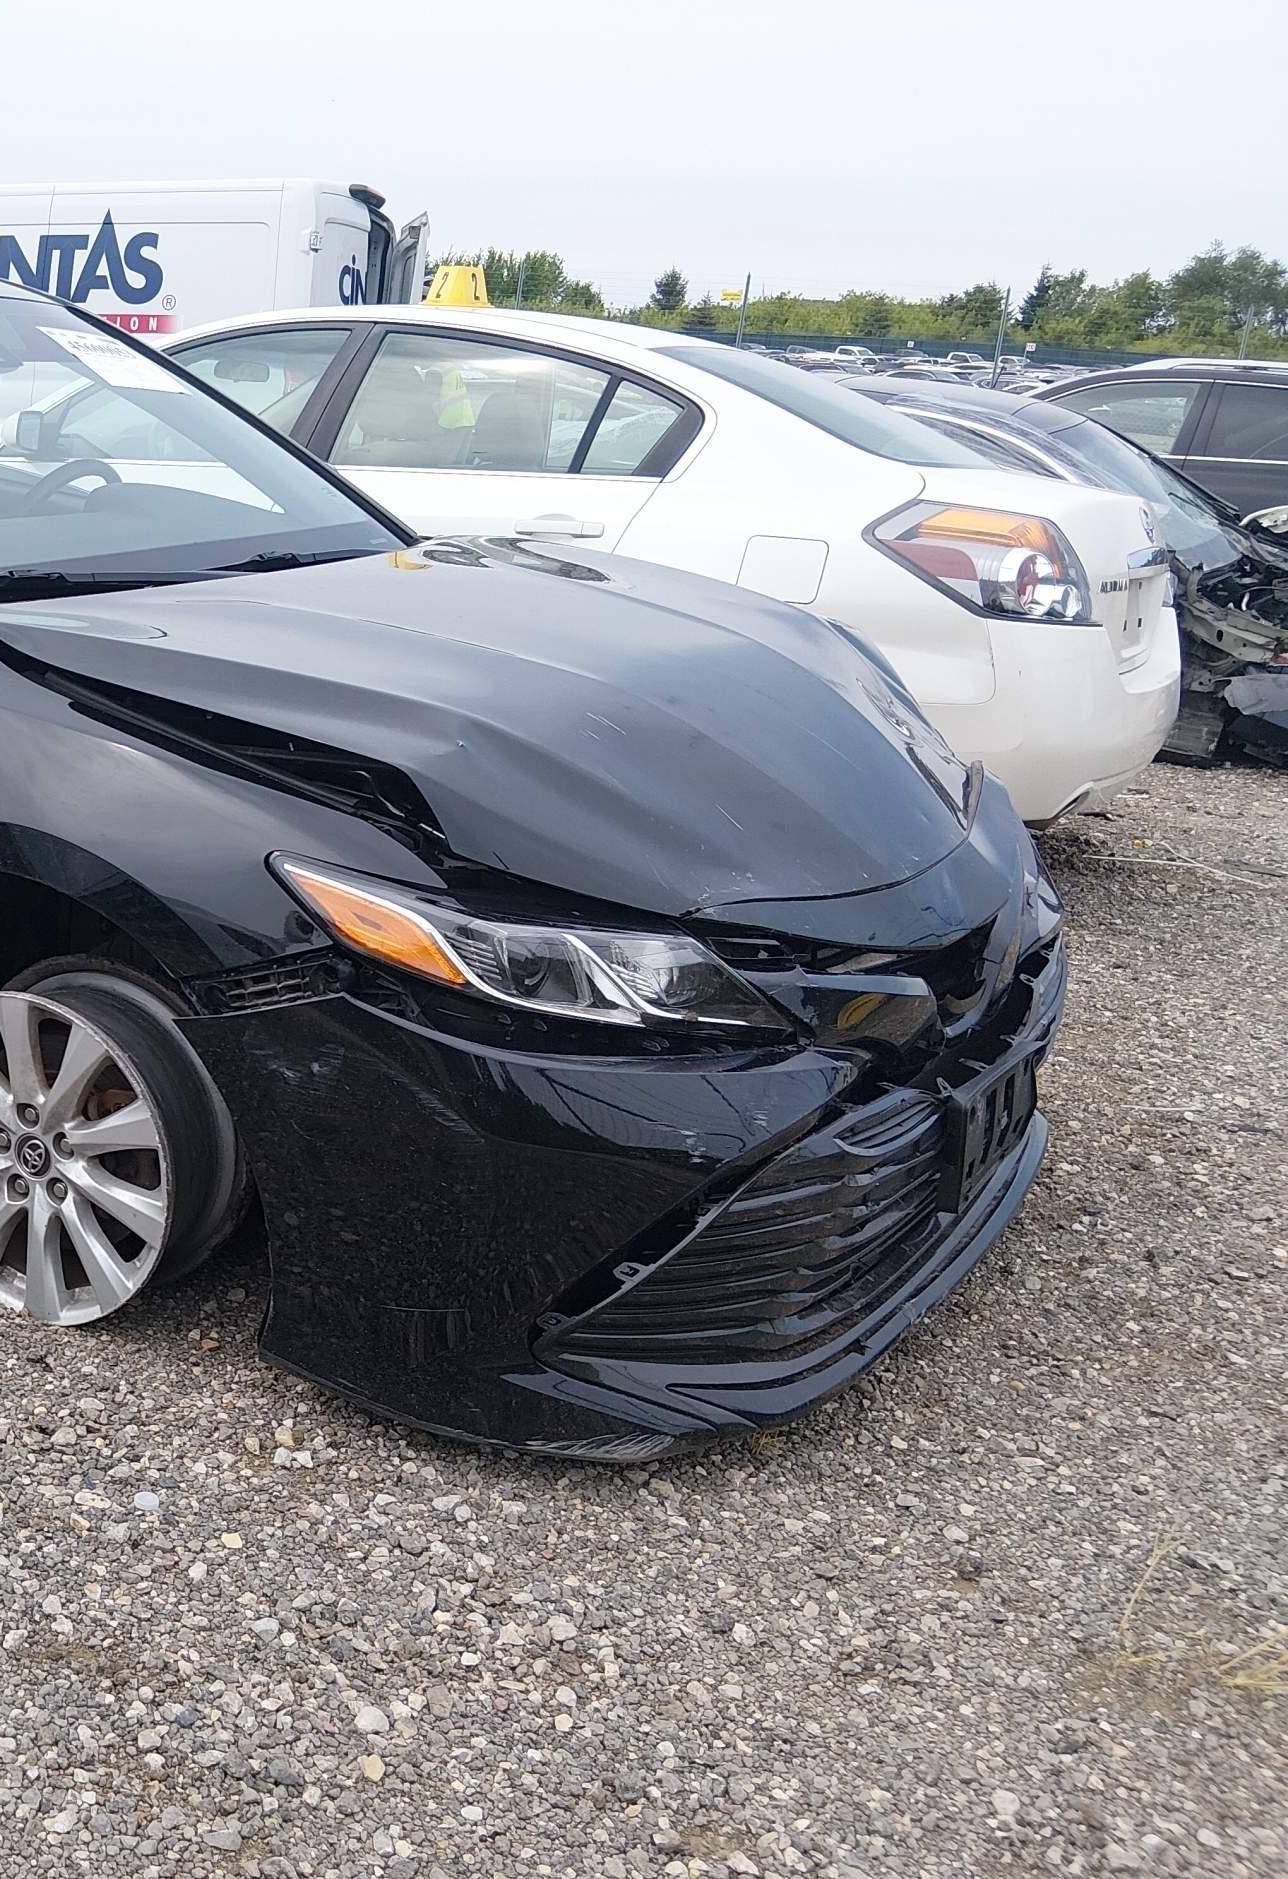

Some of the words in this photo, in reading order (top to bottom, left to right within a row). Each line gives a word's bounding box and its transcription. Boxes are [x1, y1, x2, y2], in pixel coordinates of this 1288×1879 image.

[436, 271, 450, 299] 2
[471, 272, 481, 301] 2
[102, 316, 158, 331] ION
